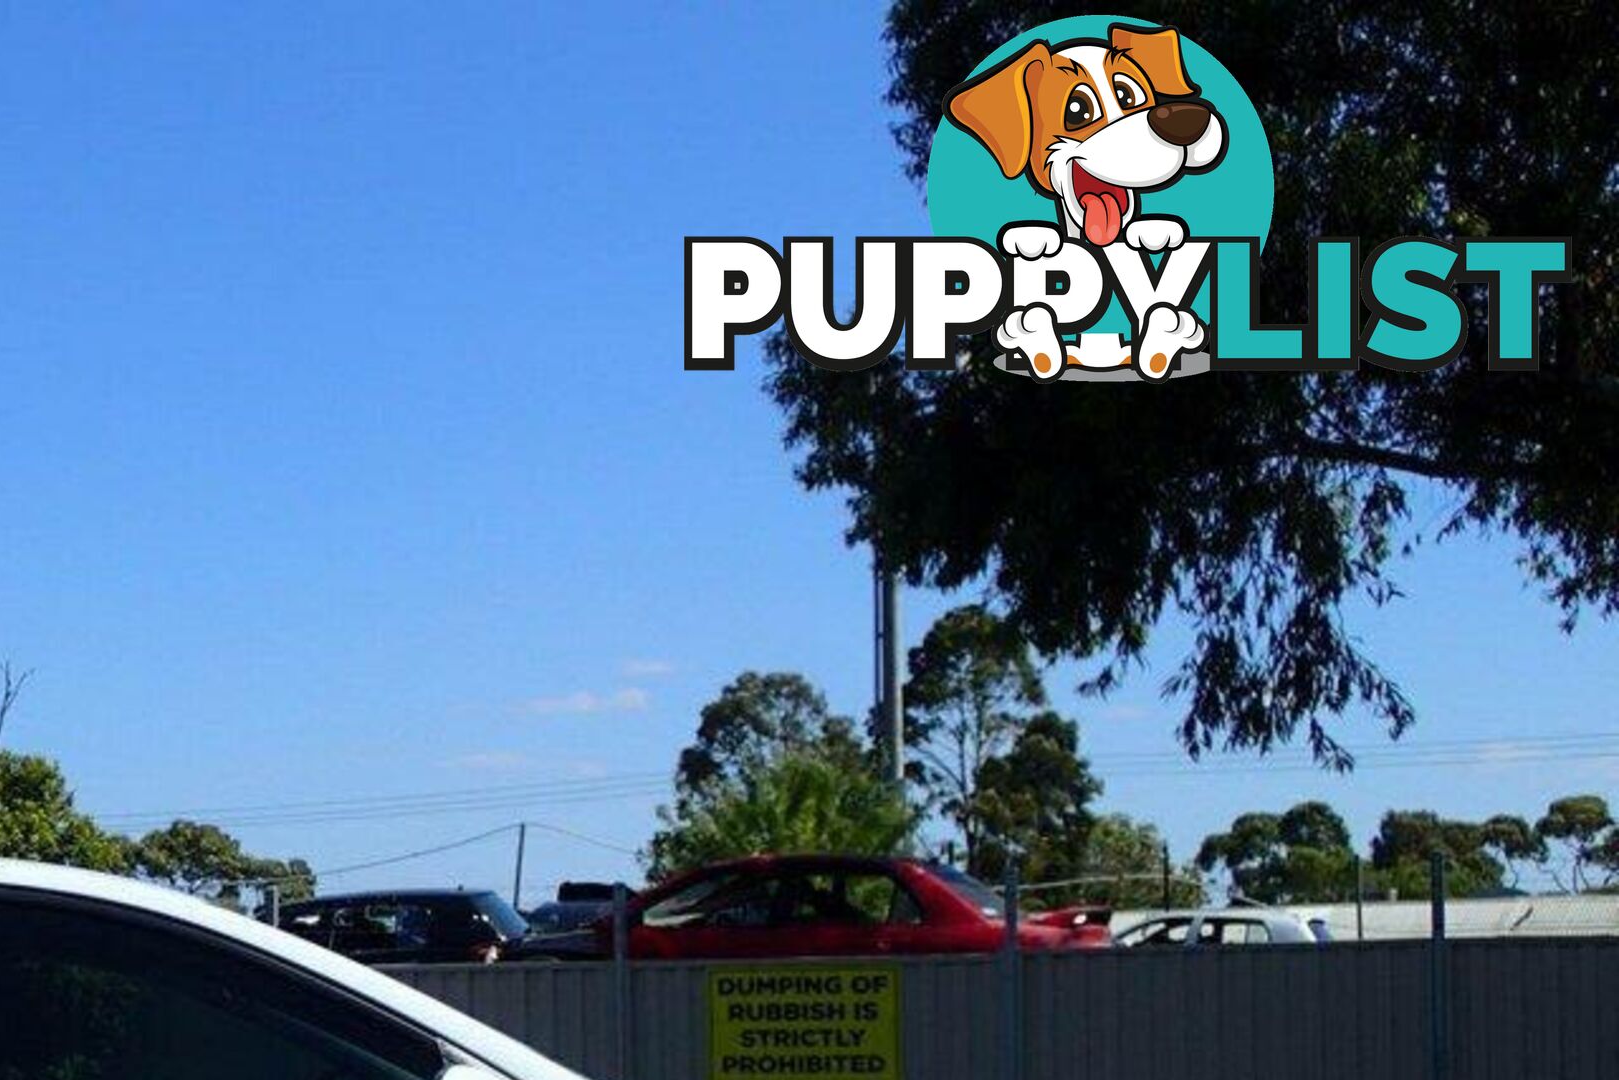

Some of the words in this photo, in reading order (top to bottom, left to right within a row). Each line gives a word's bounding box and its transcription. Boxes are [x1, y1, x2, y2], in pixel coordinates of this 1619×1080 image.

[718, 975, 842, 996] DUMPING
[851, 975, 888, 995] OF
[728, 1002, 846, 1021] RUBBISH
[854, 1001, 879, 1020] IS
[741, 1028, 867, 1048] STRICTLY
[722, 1054, 886, 1074] PROHIBITED
